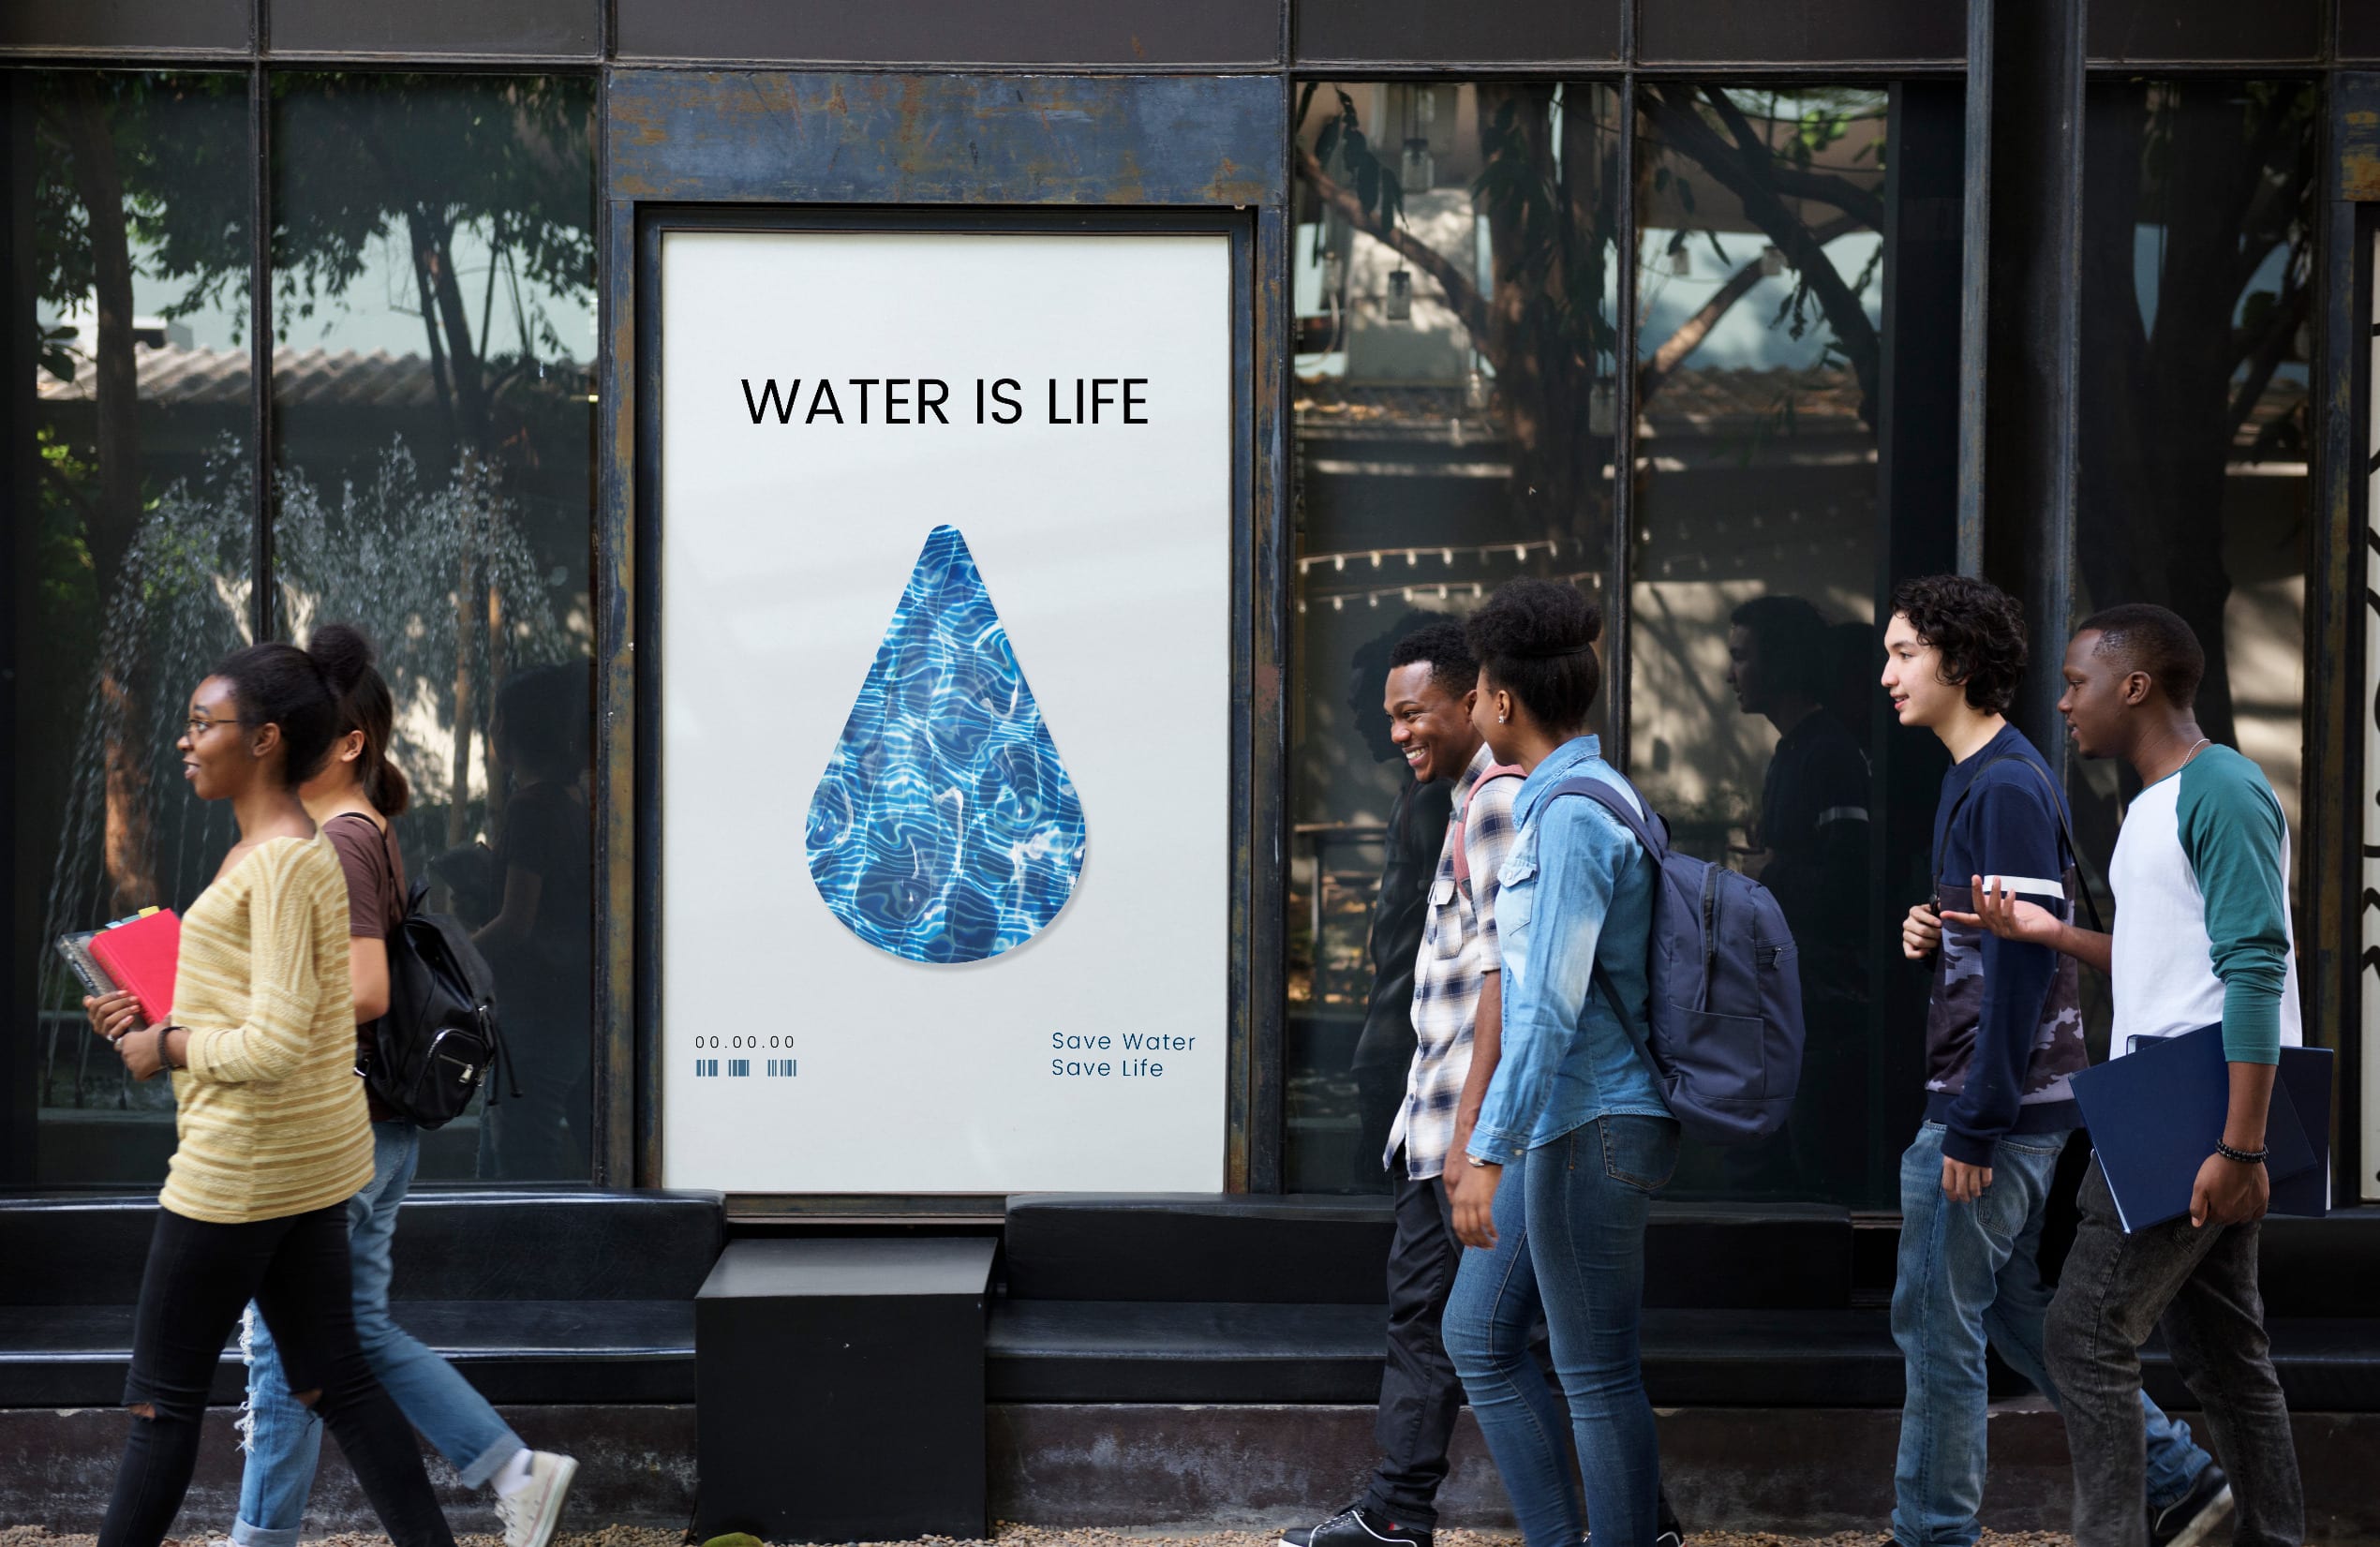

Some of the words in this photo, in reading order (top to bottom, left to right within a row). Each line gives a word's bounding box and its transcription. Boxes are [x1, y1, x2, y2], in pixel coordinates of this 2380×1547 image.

[740, 378, 951, 425] WATER
[976, 378, 1023, 425] IS
[1049, 378, 1149, 424] LIFE
[695, 1035, 795, 1049] 00.00.00
[1051, 1032, 1111, 1050] Save
[1122, 1033, 1197, 1051] Water
[1051, 1058, 1111, 1077] Save
[1123, 1058, 1164, 1078] Life
